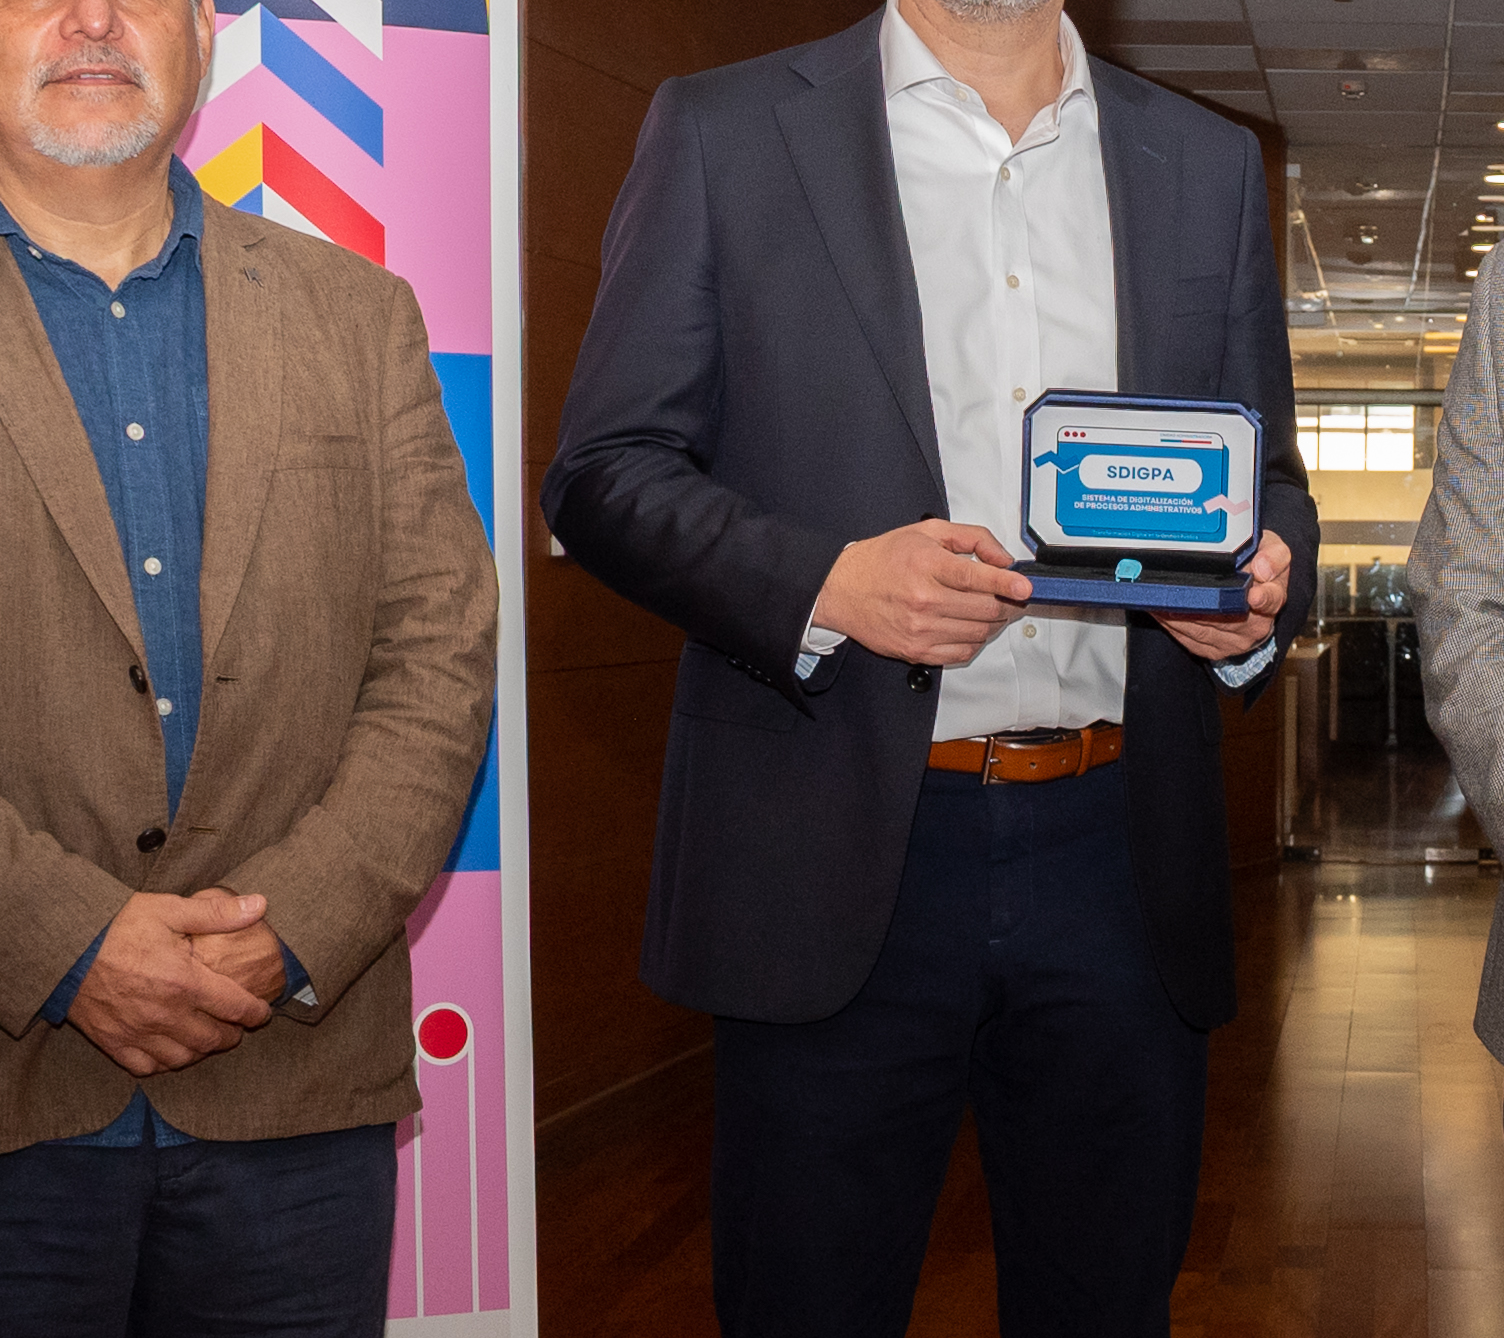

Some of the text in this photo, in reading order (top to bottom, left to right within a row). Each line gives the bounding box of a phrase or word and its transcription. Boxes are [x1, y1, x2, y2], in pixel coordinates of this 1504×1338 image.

[1107, 465, 1174, 481] SDIGPA
[1082, 494, 1116, 502] SISTEMA
[1129, 496, 1193, 506] DIGITALIZACIÓN
[1086, 502, 1128, 511] PROCESOS
[1130, 504, 1202, 514] ADMINISTRATIVOS
